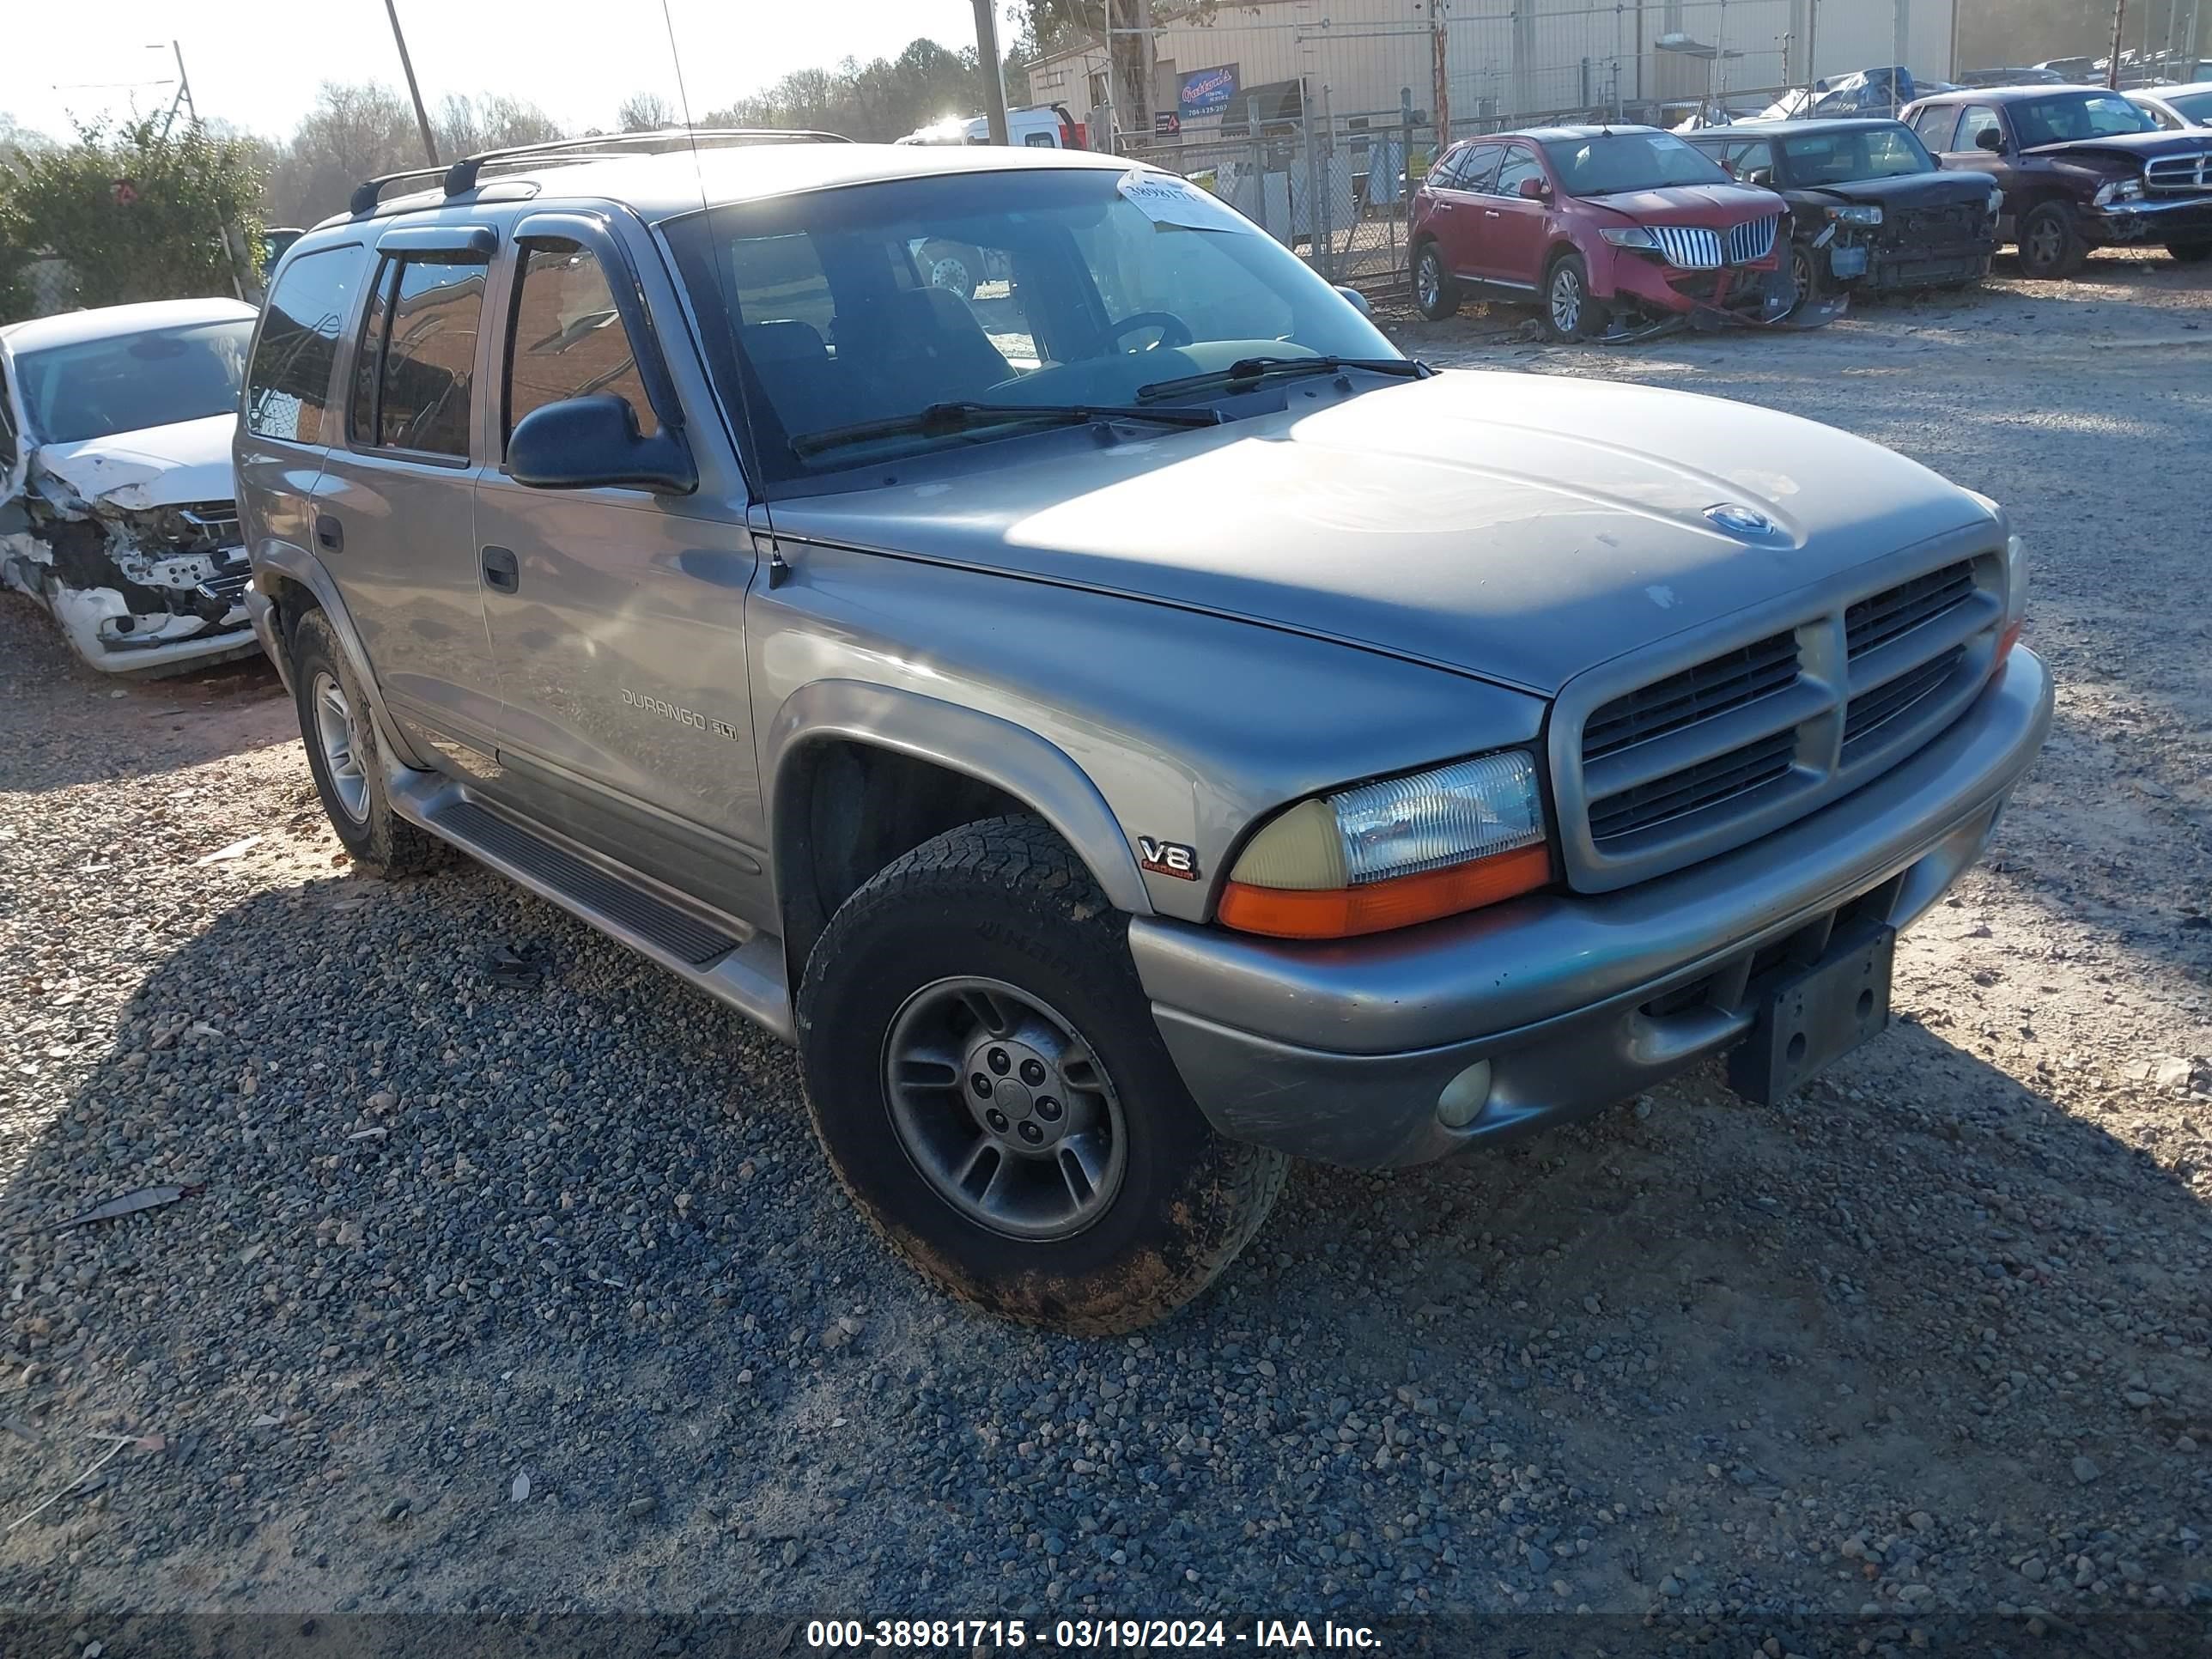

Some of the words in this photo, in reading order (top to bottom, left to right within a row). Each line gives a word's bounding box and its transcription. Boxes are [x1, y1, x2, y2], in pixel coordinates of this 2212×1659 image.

[620, 688, 708, 731] DURANGO
[711, 721, 737, 740] SLT
[1139, 839, 1192, 871] V8
